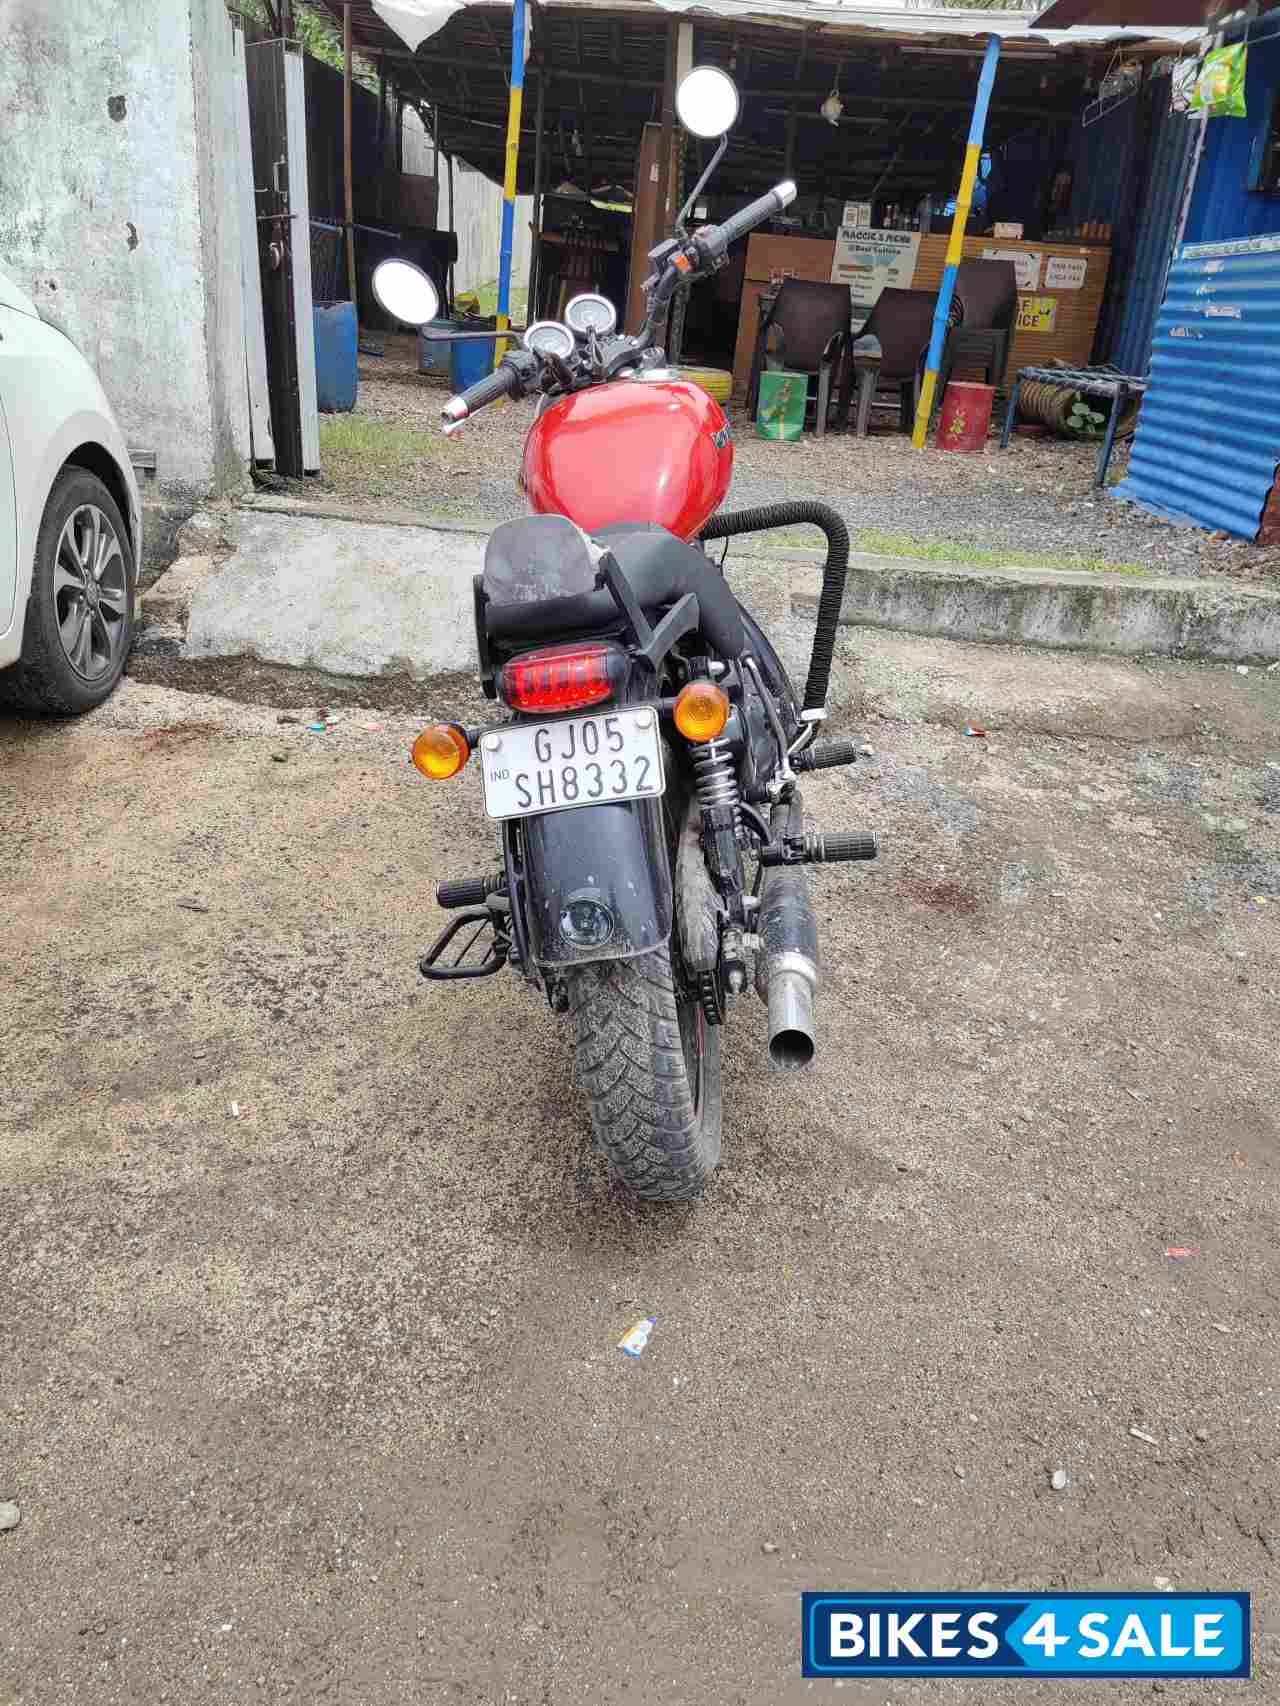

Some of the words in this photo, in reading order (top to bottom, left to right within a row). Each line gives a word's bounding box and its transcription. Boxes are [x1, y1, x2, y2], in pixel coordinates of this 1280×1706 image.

[1017, 312, 1040, 328] ICE
[534, 717, 624, 763] GJ05
[489, 768, 511, 782] IND
[514, 755, 652, 808] SH8332
